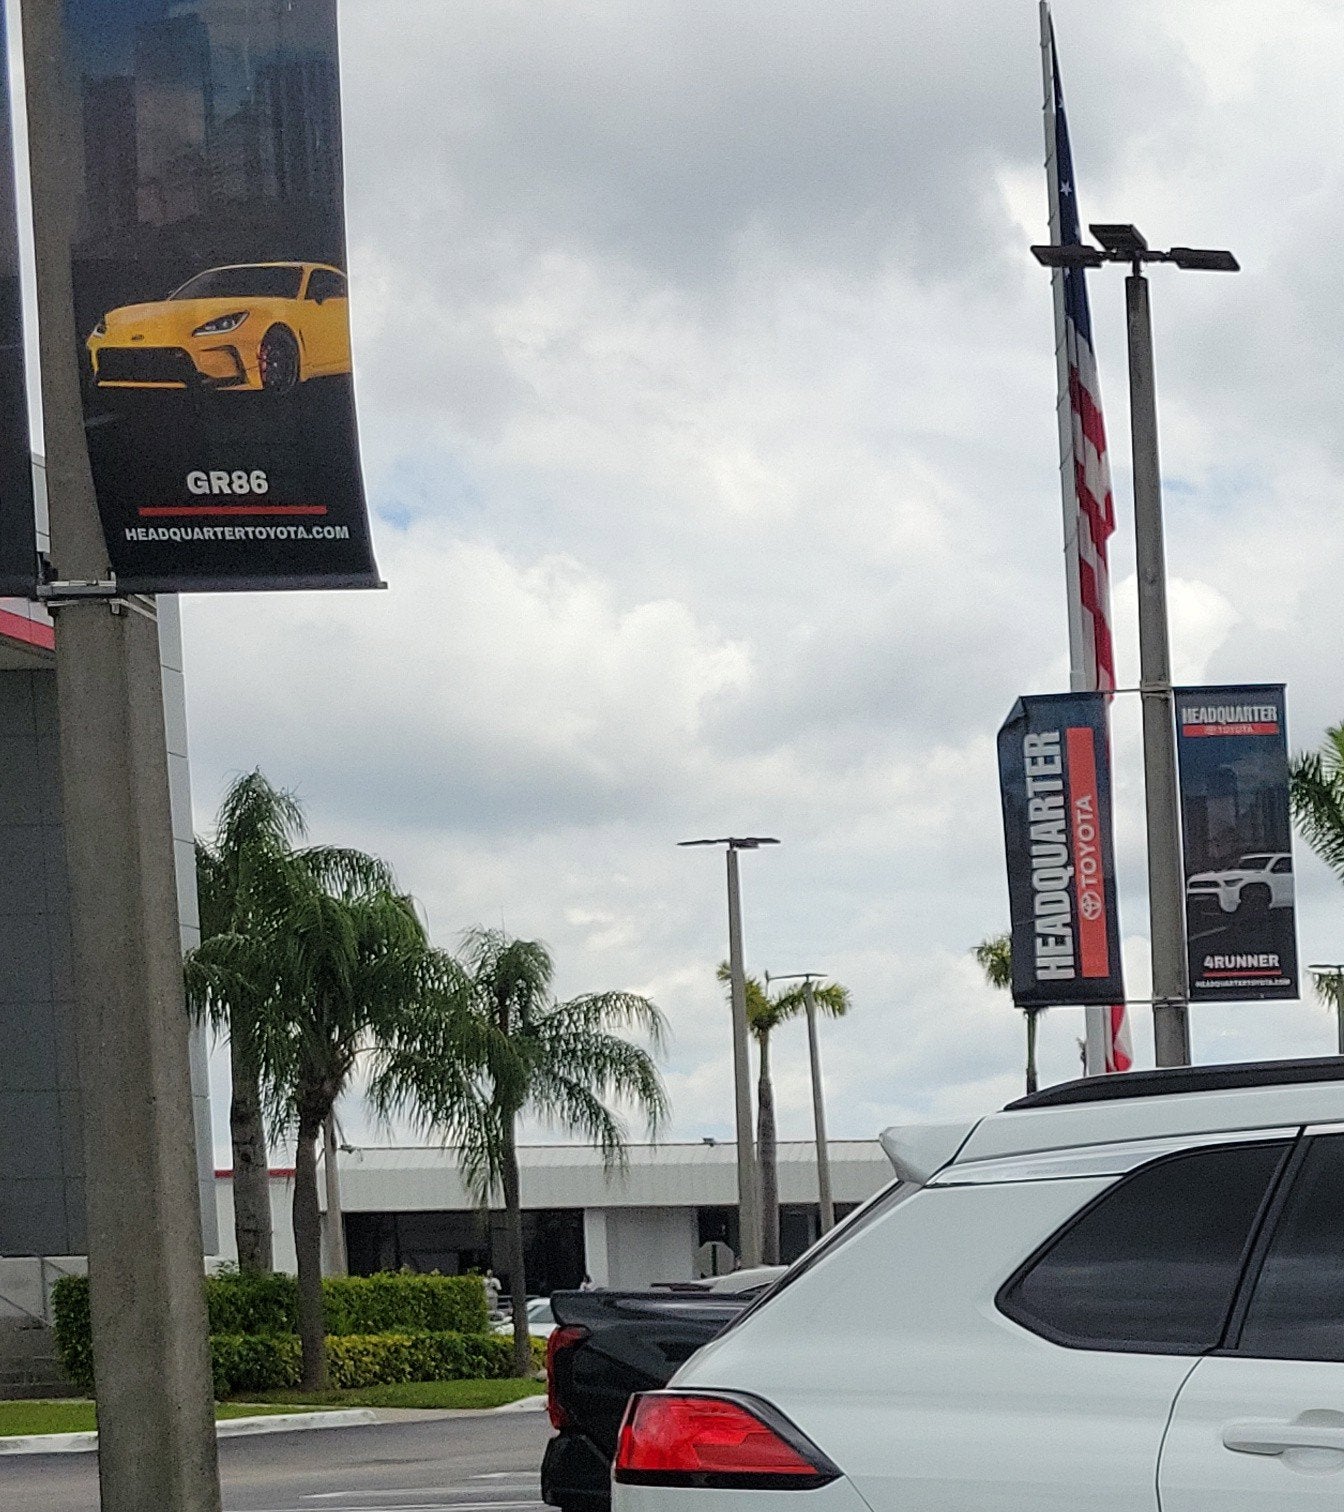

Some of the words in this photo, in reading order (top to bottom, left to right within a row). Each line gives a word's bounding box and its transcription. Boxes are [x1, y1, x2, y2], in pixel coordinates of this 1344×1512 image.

[186, 470, 269, 495] GR86
[125, 526, 349, 543] HEADQUARTERTOYOTA.COM
[1182, 705, 1278, 725] HEADQUARTER
[1075, 795, 1098, 888] TOYOTA
[1023, 729, 1075, 981] HEADQUARTER
[1203, 954, 1280, 968] 4RUNNER
